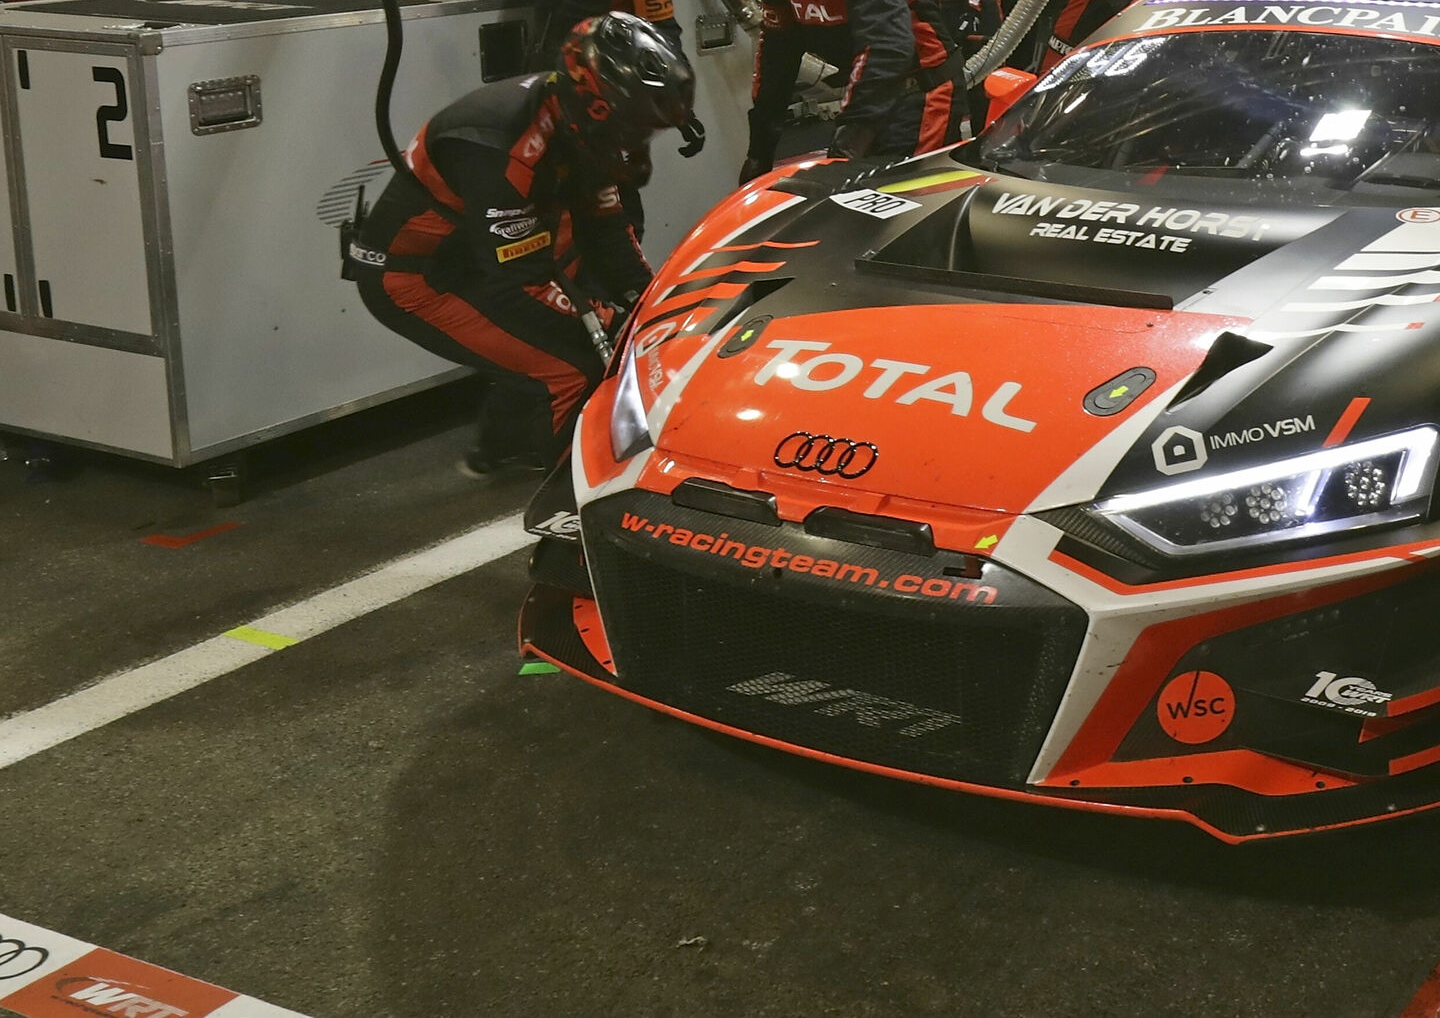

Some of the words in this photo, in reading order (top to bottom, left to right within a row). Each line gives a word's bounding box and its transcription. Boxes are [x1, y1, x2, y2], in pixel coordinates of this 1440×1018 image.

[91, 65, 134, 161] 2
[843, 192, 907, 214] PRO
[991, 192, 1052, 219] VAN
[1060, 198, 1140, 225] DER
[1137, 205, 1287, 243] HORST
[1029, 221, 1092, 242] REAL
[1097, 226, 1193, 254] ESTATE
[753, 338, 1038, 434] TOTAL
[619, 509, 1000, 605] w-racingteam.com
[1300, 697, 1337, 708] 2009
[1344, 706, 1378, 718] 2019
[1340, 690, 1392, 704] WRT
[70, 982, 190, 1018] WRT
